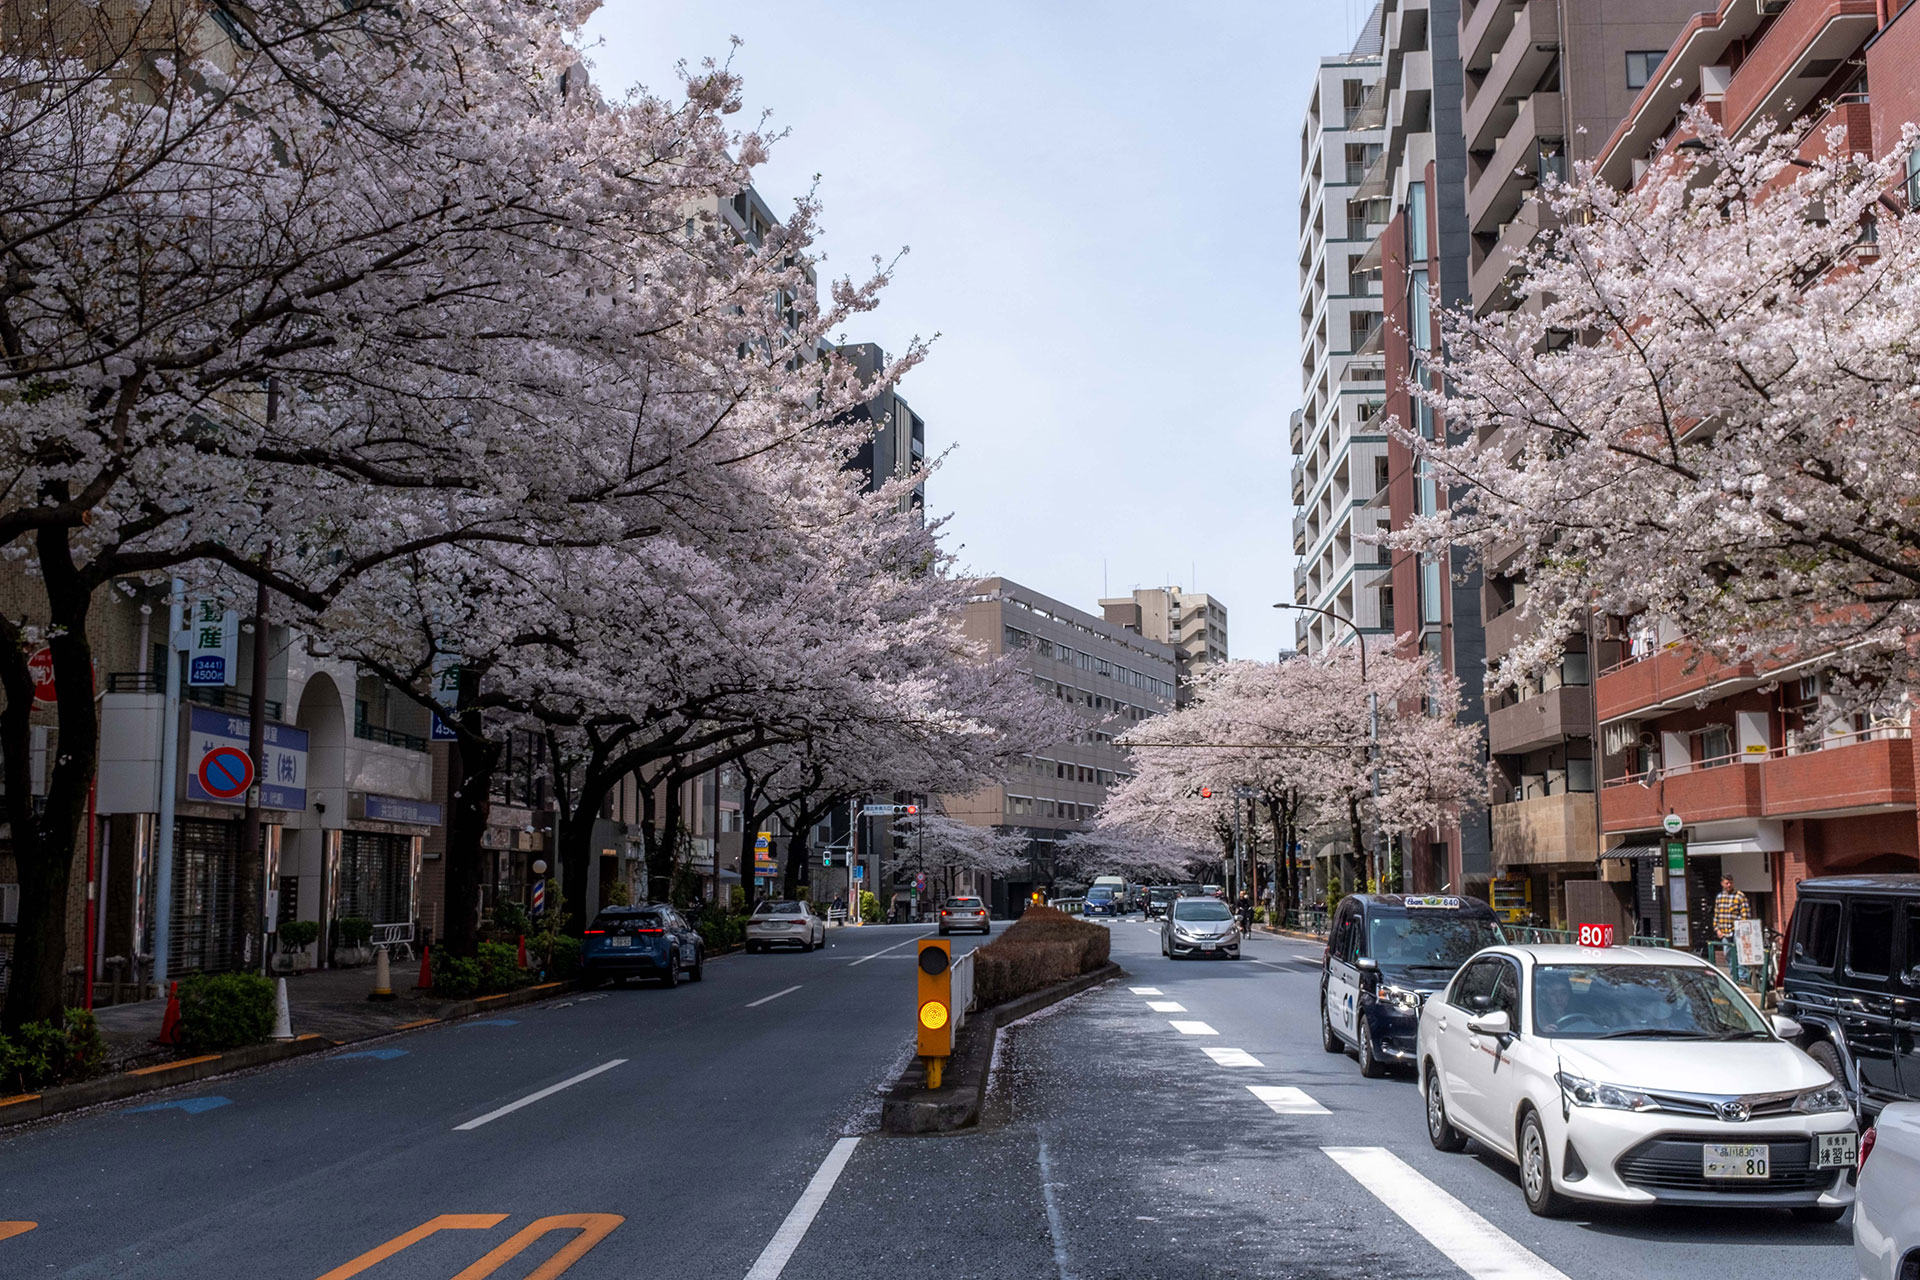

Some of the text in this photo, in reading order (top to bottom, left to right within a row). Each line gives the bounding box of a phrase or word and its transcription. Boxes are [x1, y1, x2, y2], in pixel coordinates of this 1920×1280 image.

[195, 660, 223, 670] (3441)
[1443, 898, 1459, 906] 640
[1581, 926, 1602, 946] 80
[1604, 927, 1613, 946] 80
[1820, 1147, 1855, 1165] 練習中
[1746, 1159, 1766, 1176] 80
